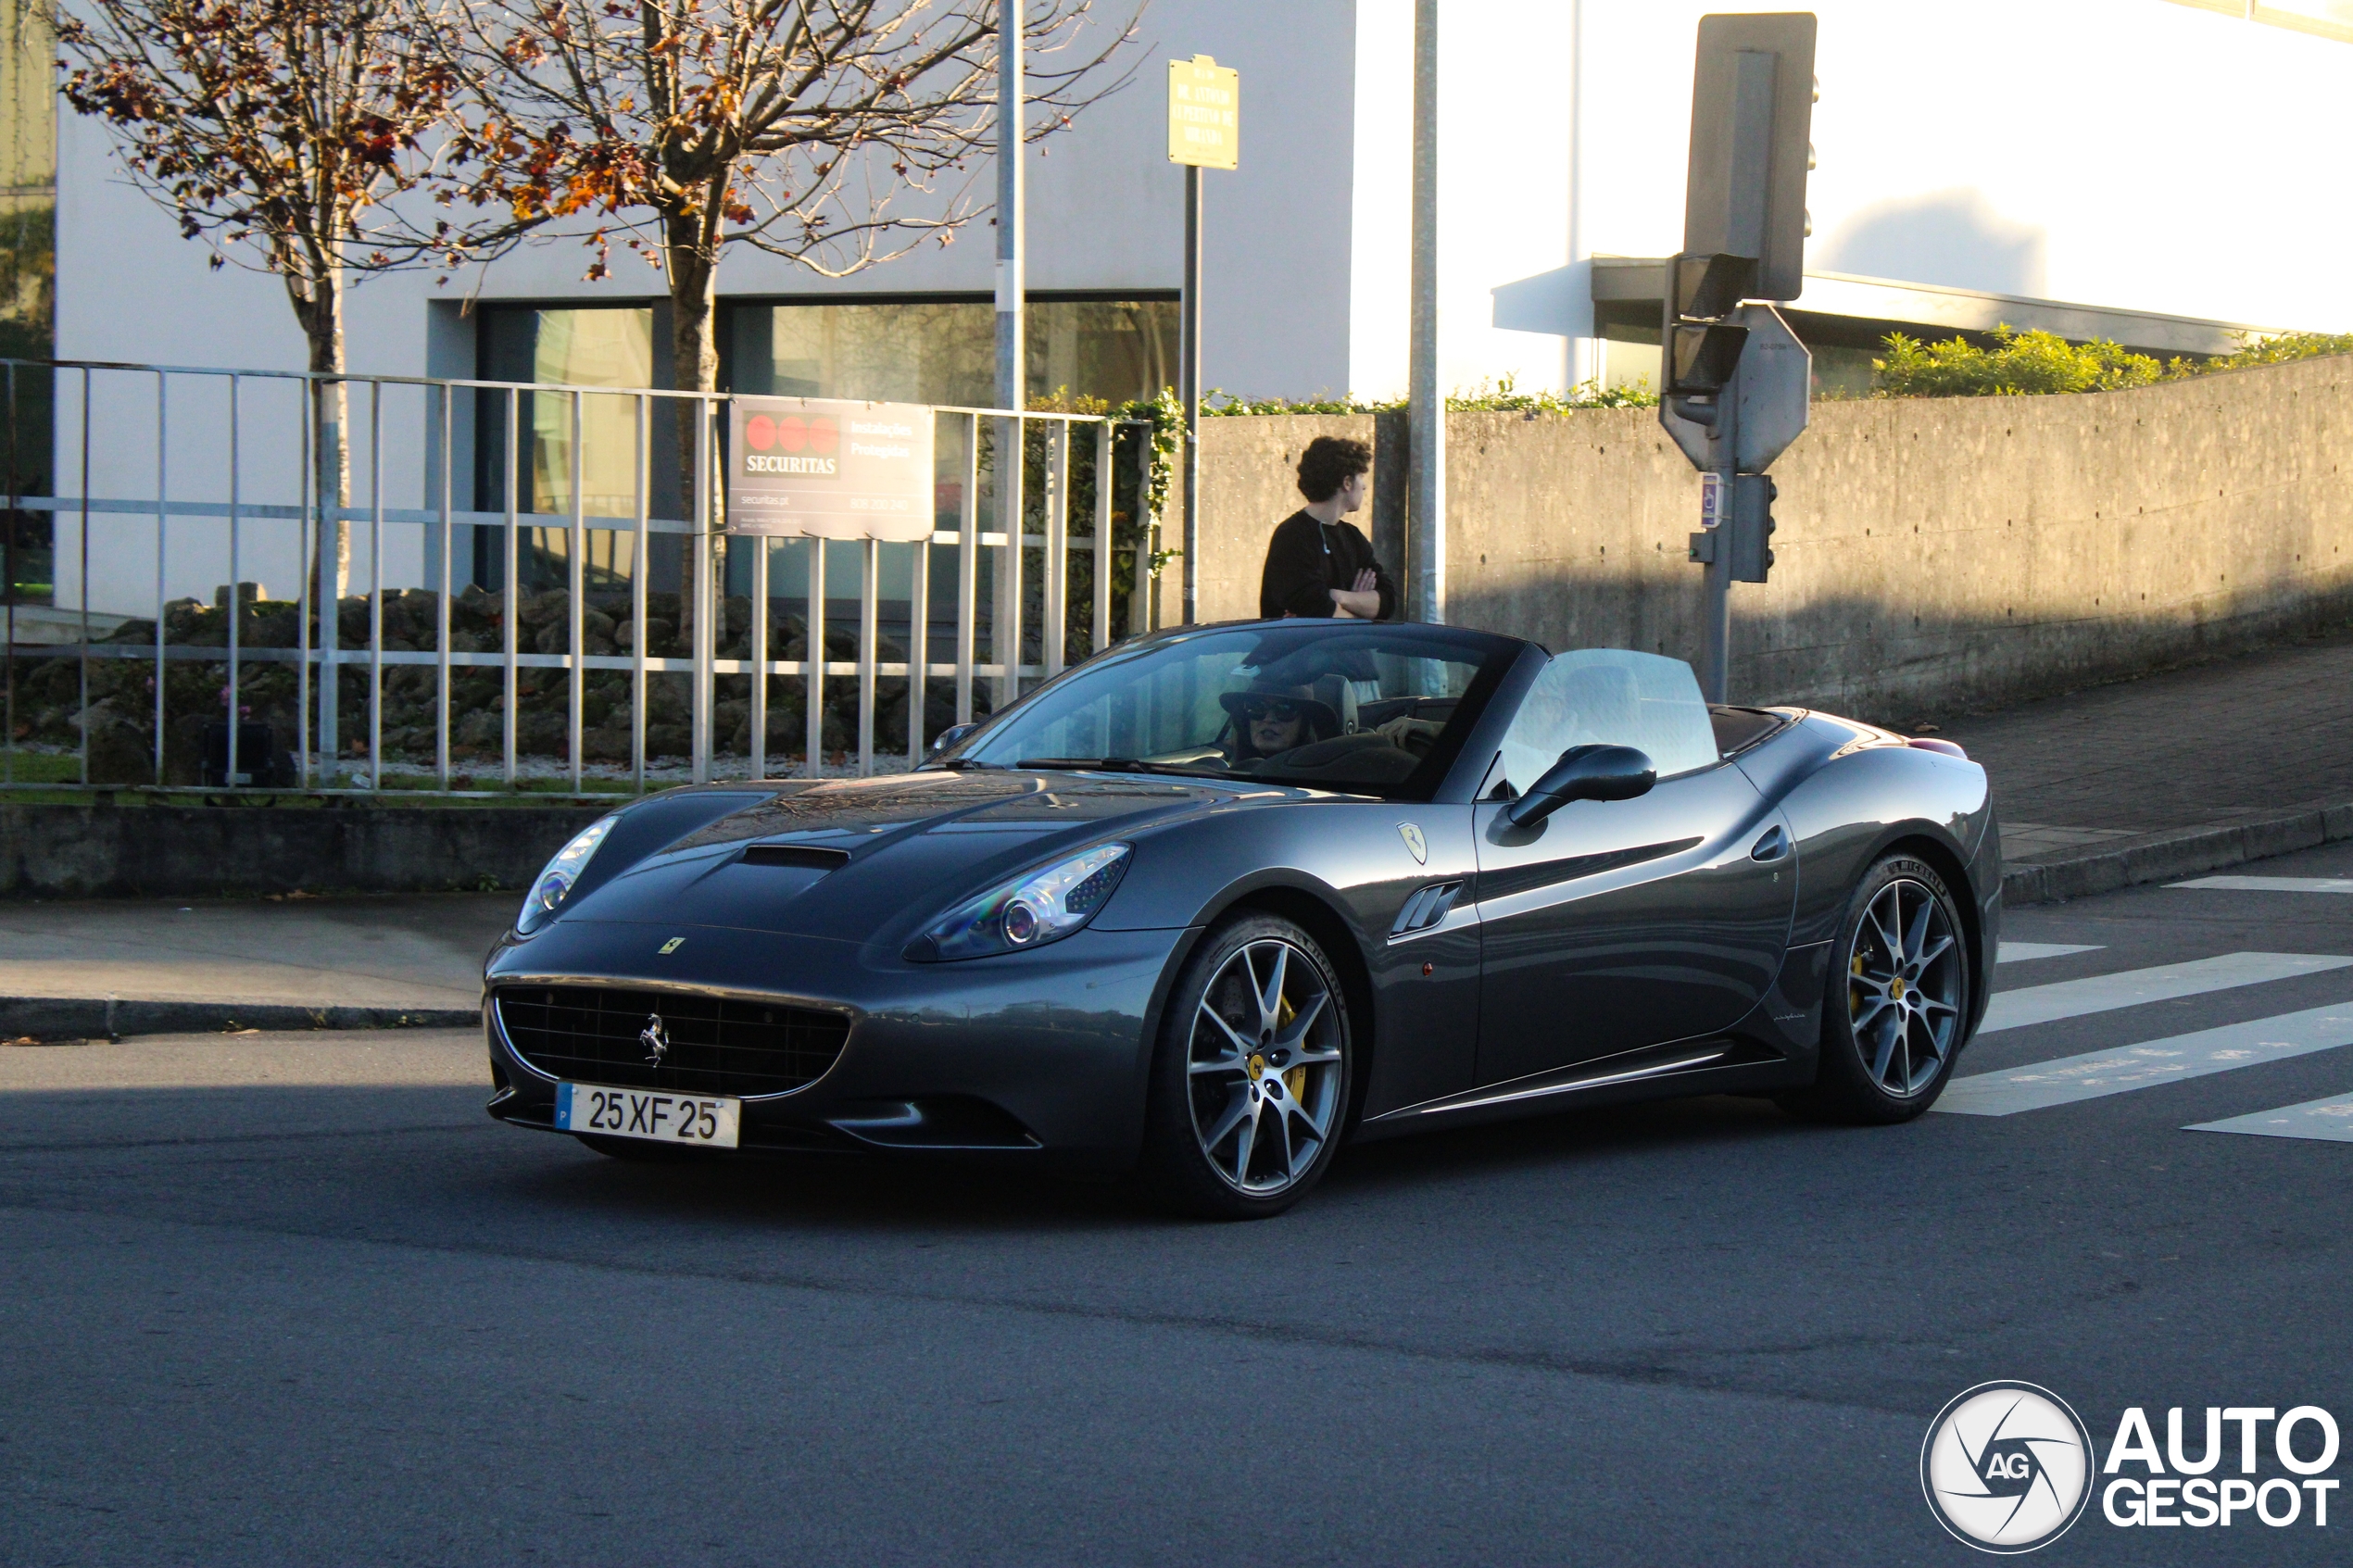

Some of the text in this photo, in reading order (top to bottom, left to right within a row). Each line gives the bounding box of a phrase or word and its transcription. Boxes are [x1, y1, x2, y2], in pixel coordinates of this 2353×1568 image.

[851, 420, 912, 438] Instalações
[851, 442, 910, 458] Protegidas
[747, 455, 836, 474] SECURITAS
[741, 495, 789, 508] securitas.pt
[850, 497, 908, 511] 808 200 240
[1900, 860, 1945, 895] MICHELIN
[560, 1110, 566, 1120] P
